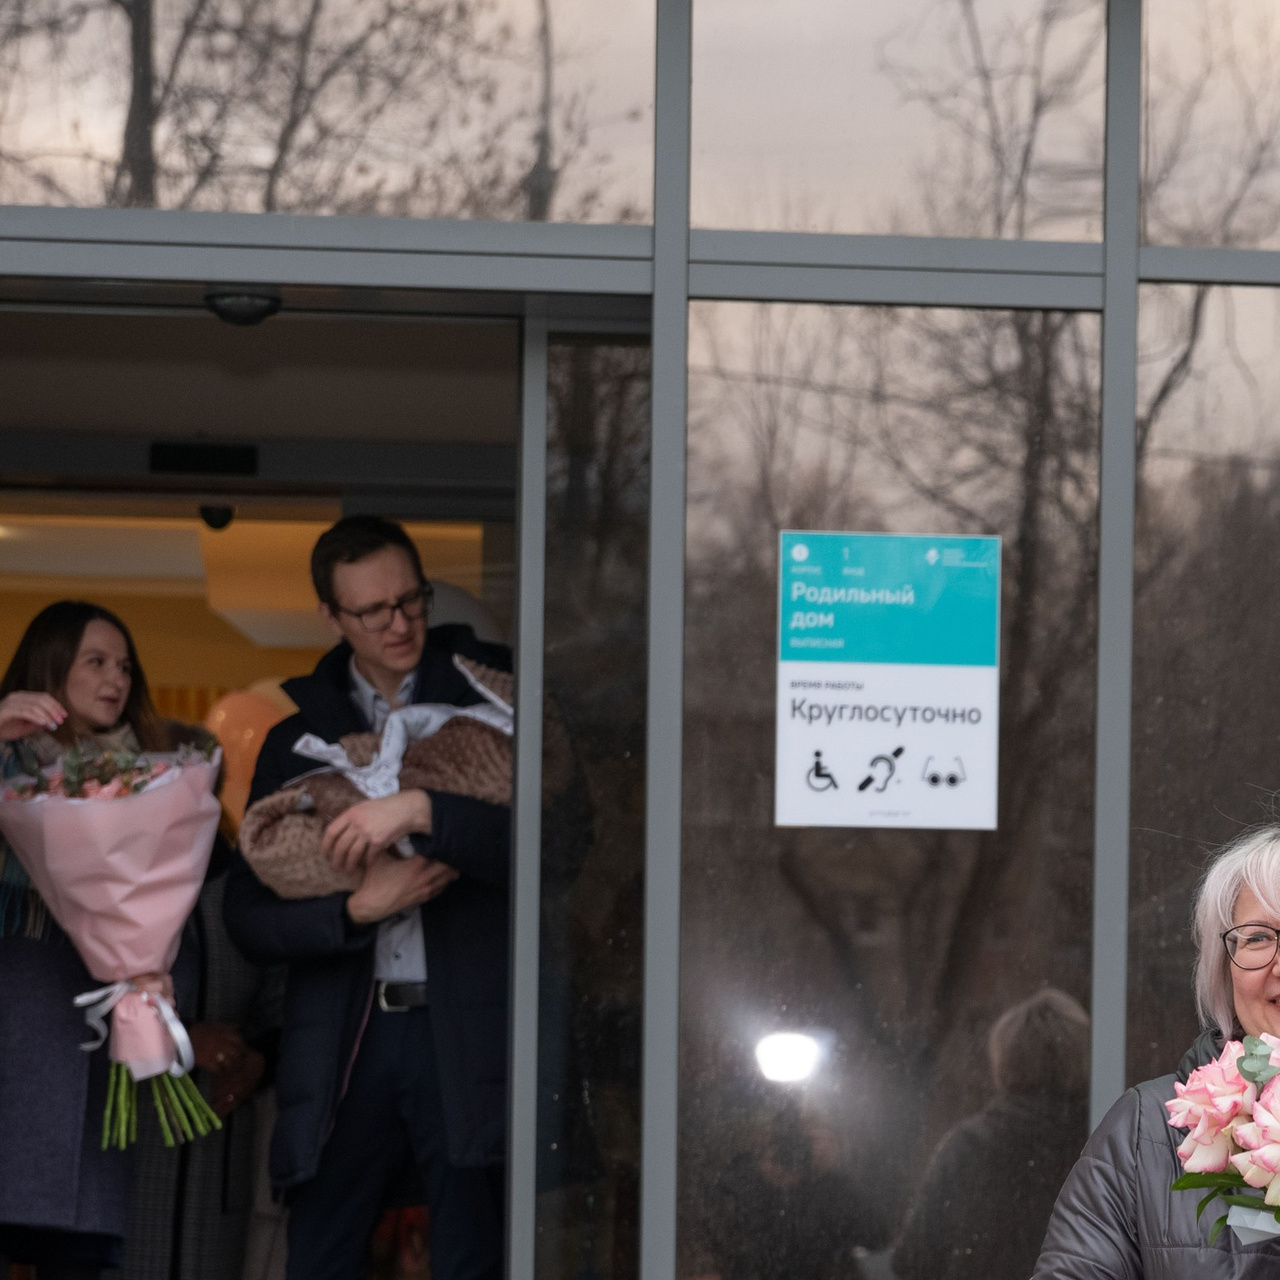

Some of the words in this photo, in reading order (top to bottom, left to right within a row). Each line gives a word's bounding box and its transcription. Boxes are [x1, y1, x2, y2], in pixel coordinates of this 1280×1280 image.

[791, 581, 915, 605] Родильный
[789, 611, 834, 630] дом
[790, 698, 982, 727] Круглосуточно
